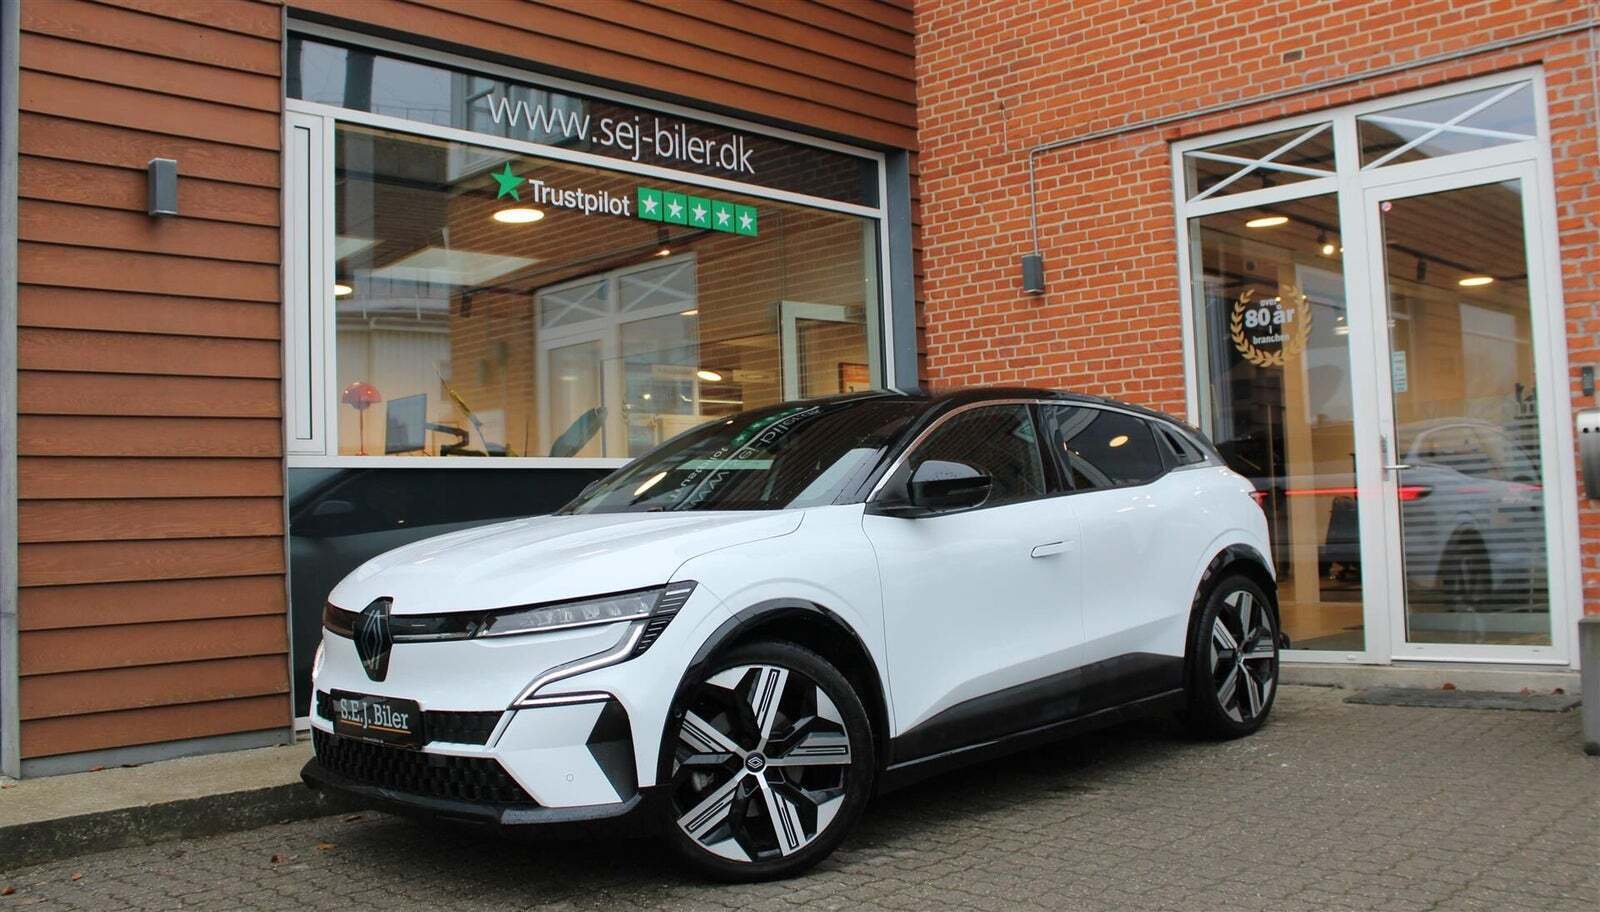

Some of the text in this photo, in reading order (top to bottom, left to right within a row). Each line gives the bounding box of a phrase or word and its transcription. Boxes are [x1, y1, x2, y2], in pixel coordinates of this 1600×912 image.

[487, 94, 756, 174] www.sej-biler.dk
[528, 179, 631, 217] Trustpilot
[1245, 304, 1295, 328] 80 år
[340, 698, 409, 730] S.E.J. Biler
